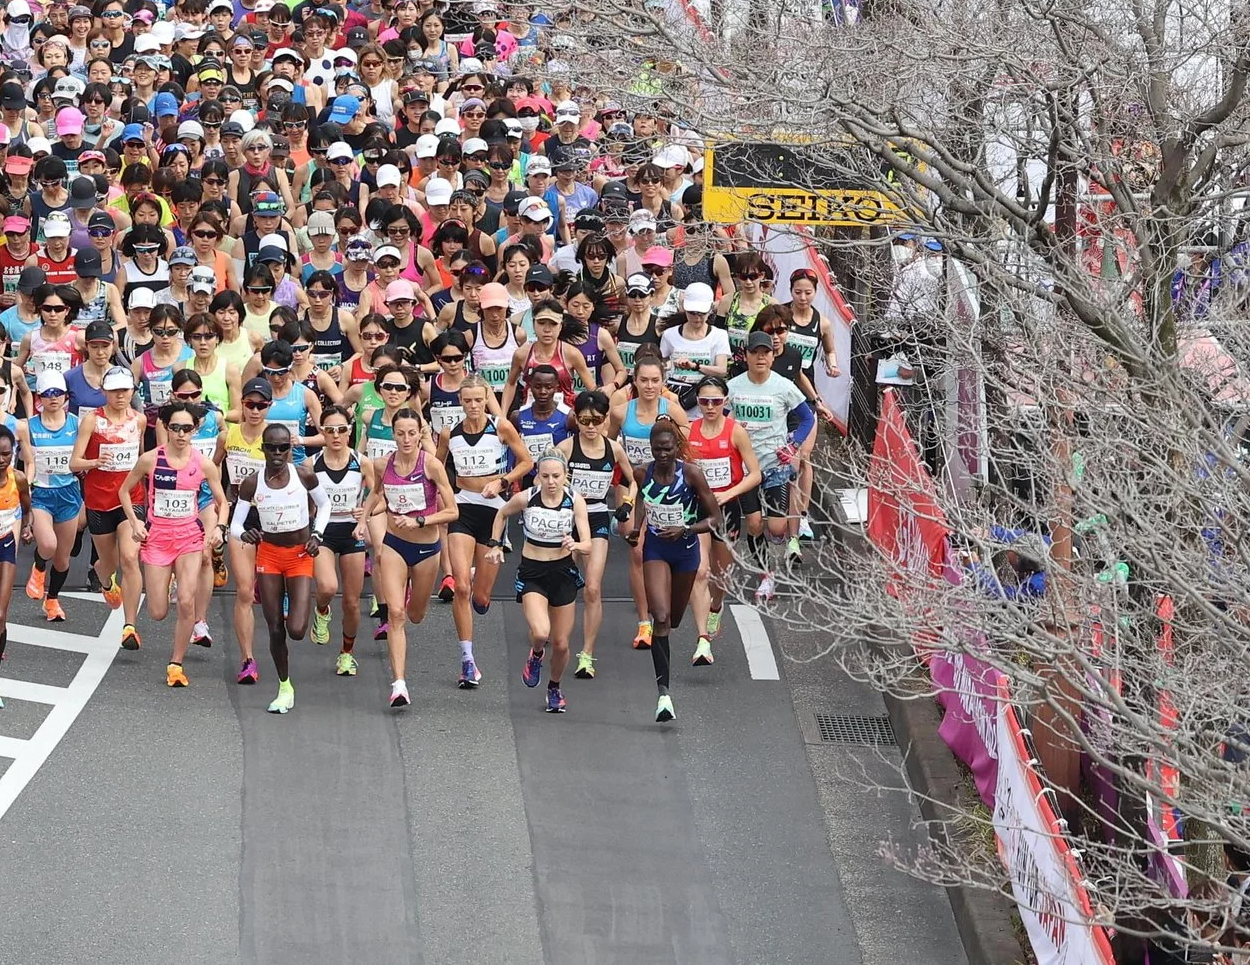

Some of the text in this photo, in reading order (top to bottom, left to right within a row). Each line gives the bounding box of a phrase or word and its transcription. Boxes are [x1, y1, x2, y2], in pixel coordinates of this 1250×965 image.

[748, 193, 883, 222] SEIKO
[41, 361, 62, 371] 148
[735, 405, 771, 419] A10031
[627, 444, 652, 455] PAC
[45, 456, 69, 466] 118
[115, 452, 132, 462] 04
[462, 456, 486, 466] 112
[164, 498, 187, 509] 103
[399, 494, 407, 504] 8
[276, 512, 283, 522] 7
[531, 516, 572, 529] PACE4
